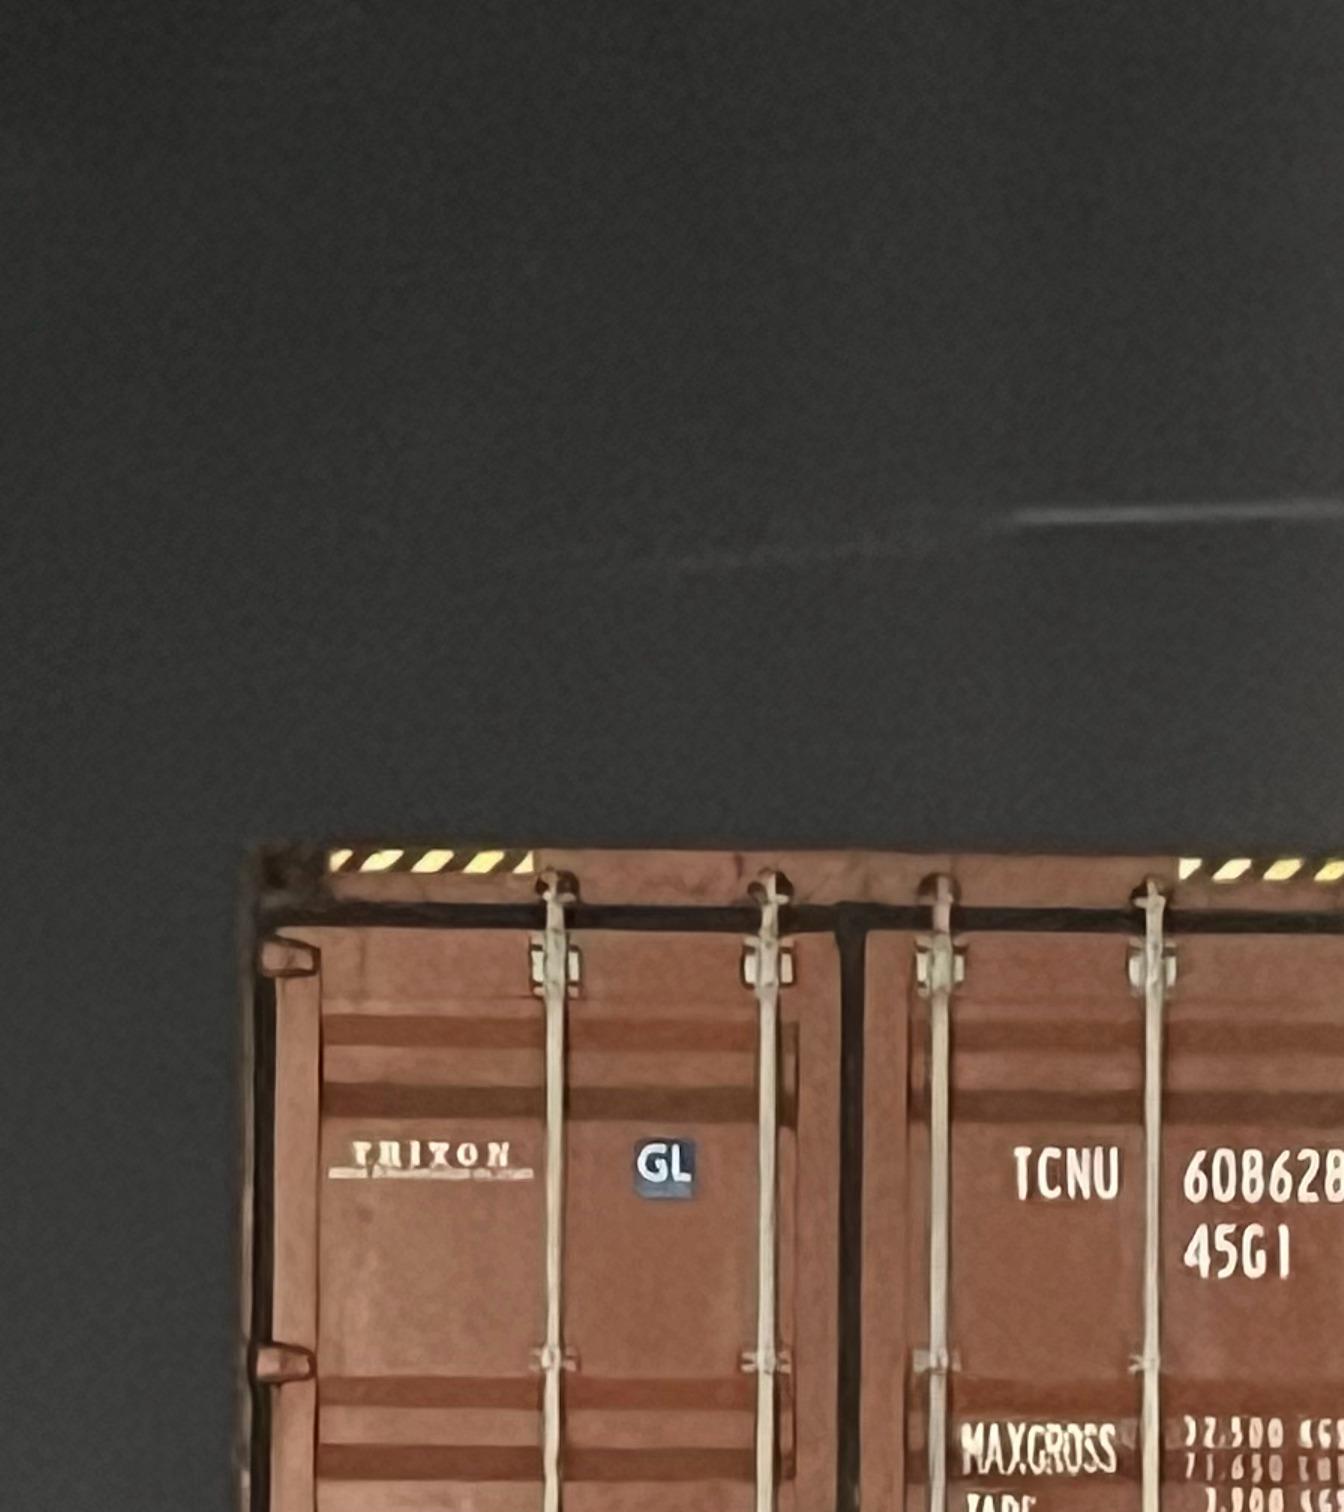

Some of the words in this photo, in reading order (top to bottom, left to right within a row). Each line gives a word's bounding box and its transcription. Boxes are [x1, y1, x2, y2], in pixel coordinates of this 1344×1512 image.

[637, 1143, 692, 1182] GL
[1014, 1146, 1119, 1200] TCNU
[1183, 1223, 1291, 1279] 45G1
